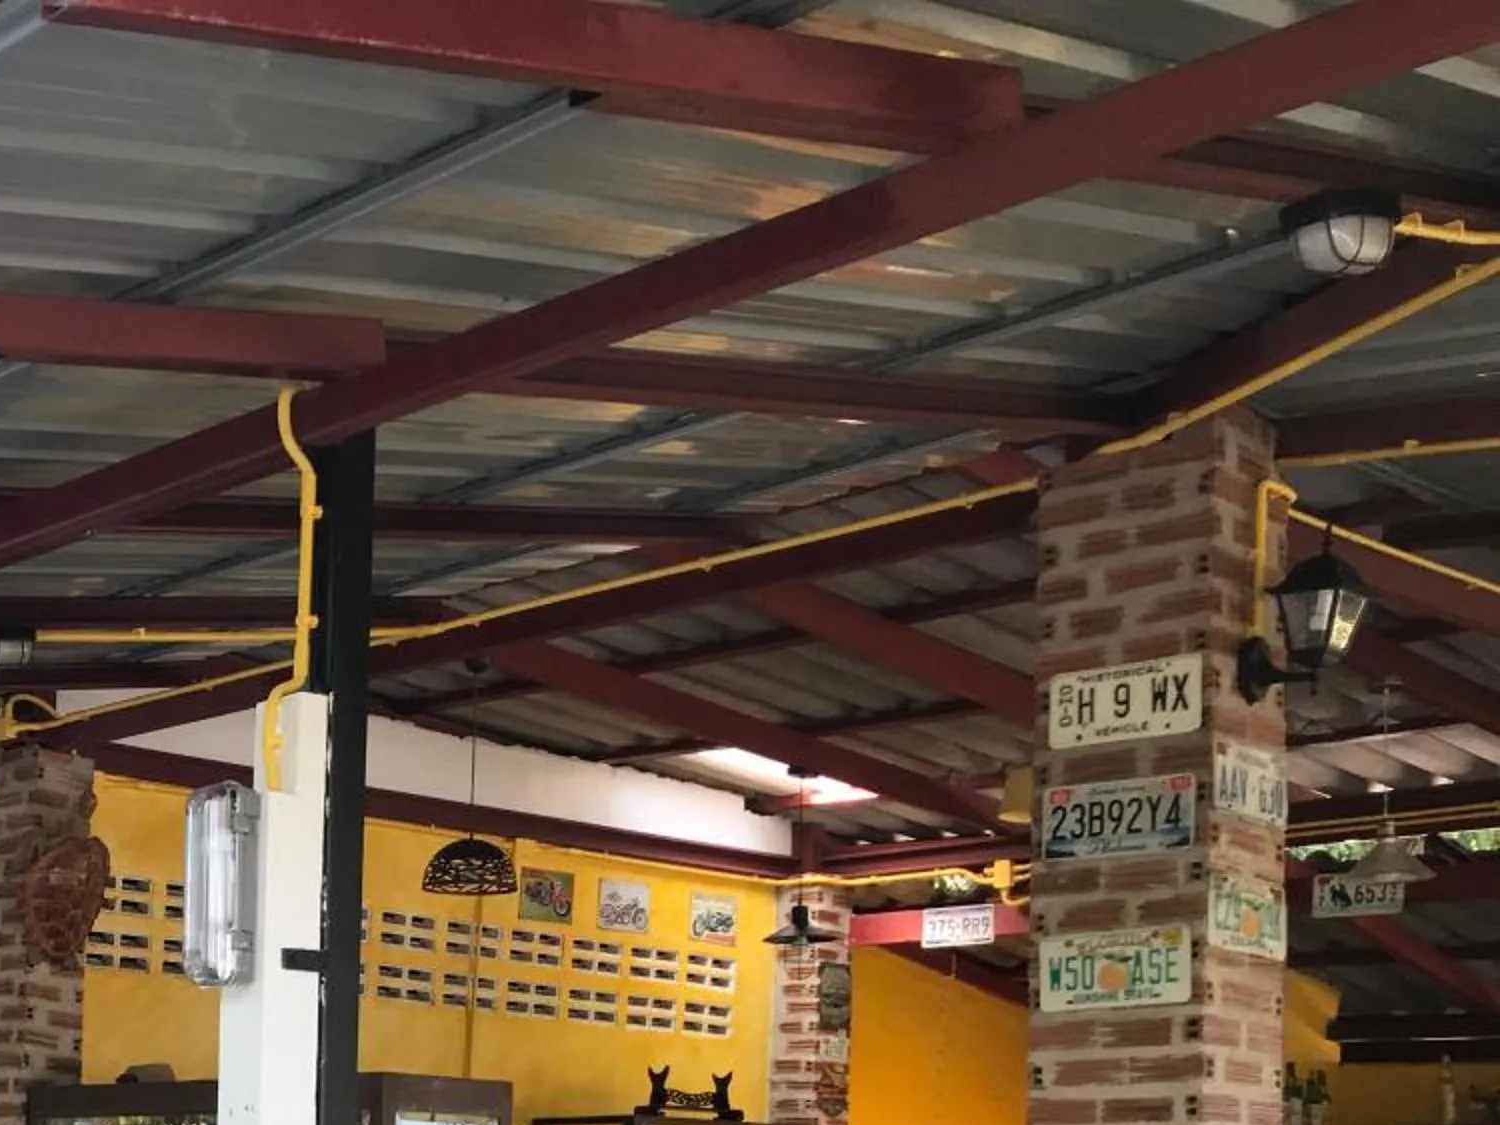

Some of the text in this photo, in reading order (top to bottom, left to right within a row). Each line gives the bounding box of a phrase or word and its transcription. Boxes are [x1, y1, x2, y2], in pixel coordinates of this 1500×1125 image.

[1077, 673, 1190, 725] H 9 WX
[1051, 791, 1182, 841] 23B92Y4
[1131, 946, 1180, 987] ASE
